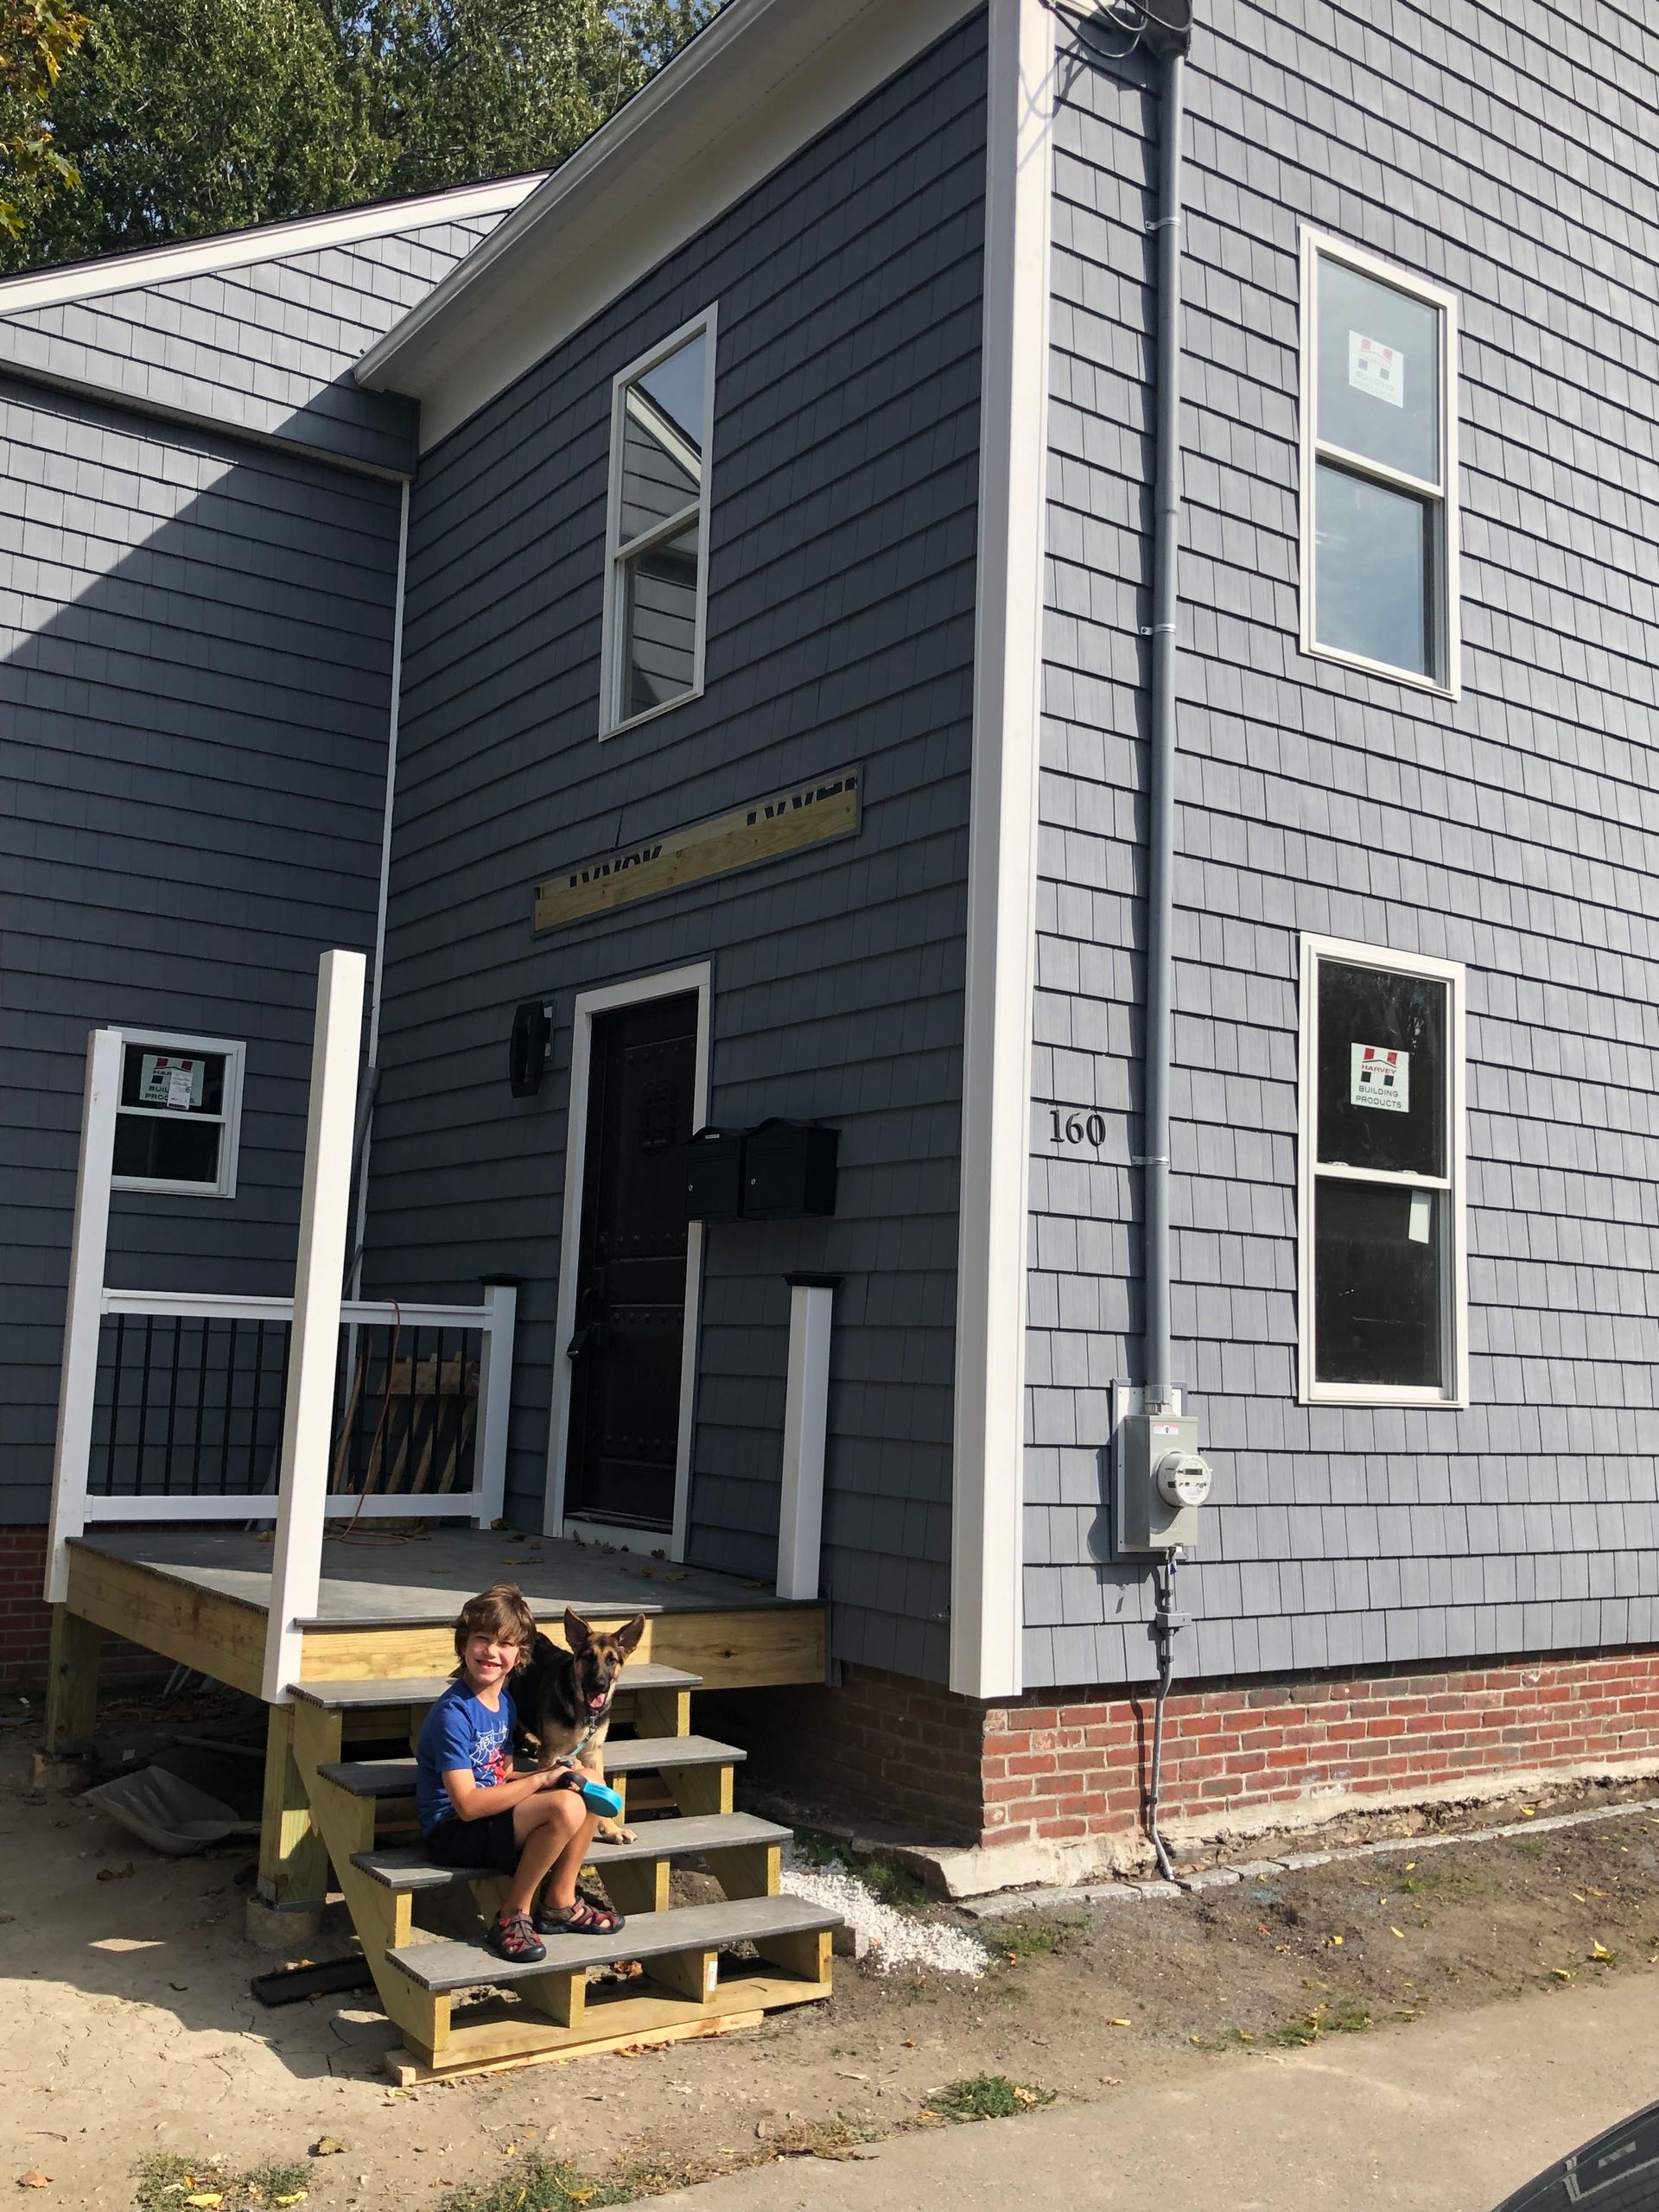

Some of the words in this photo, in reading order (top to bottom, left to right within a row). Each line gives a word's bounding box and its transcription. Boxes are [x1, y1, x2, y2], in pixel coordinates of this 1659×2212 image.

[1362, 1065, 1396, 1074] HARVEY
[1358, 1085, 1398, 1097] BUILDING
[1356, 1096, 1402, 1109] PRODUCTS
[1050, 1110, 1106, 1147] 160
